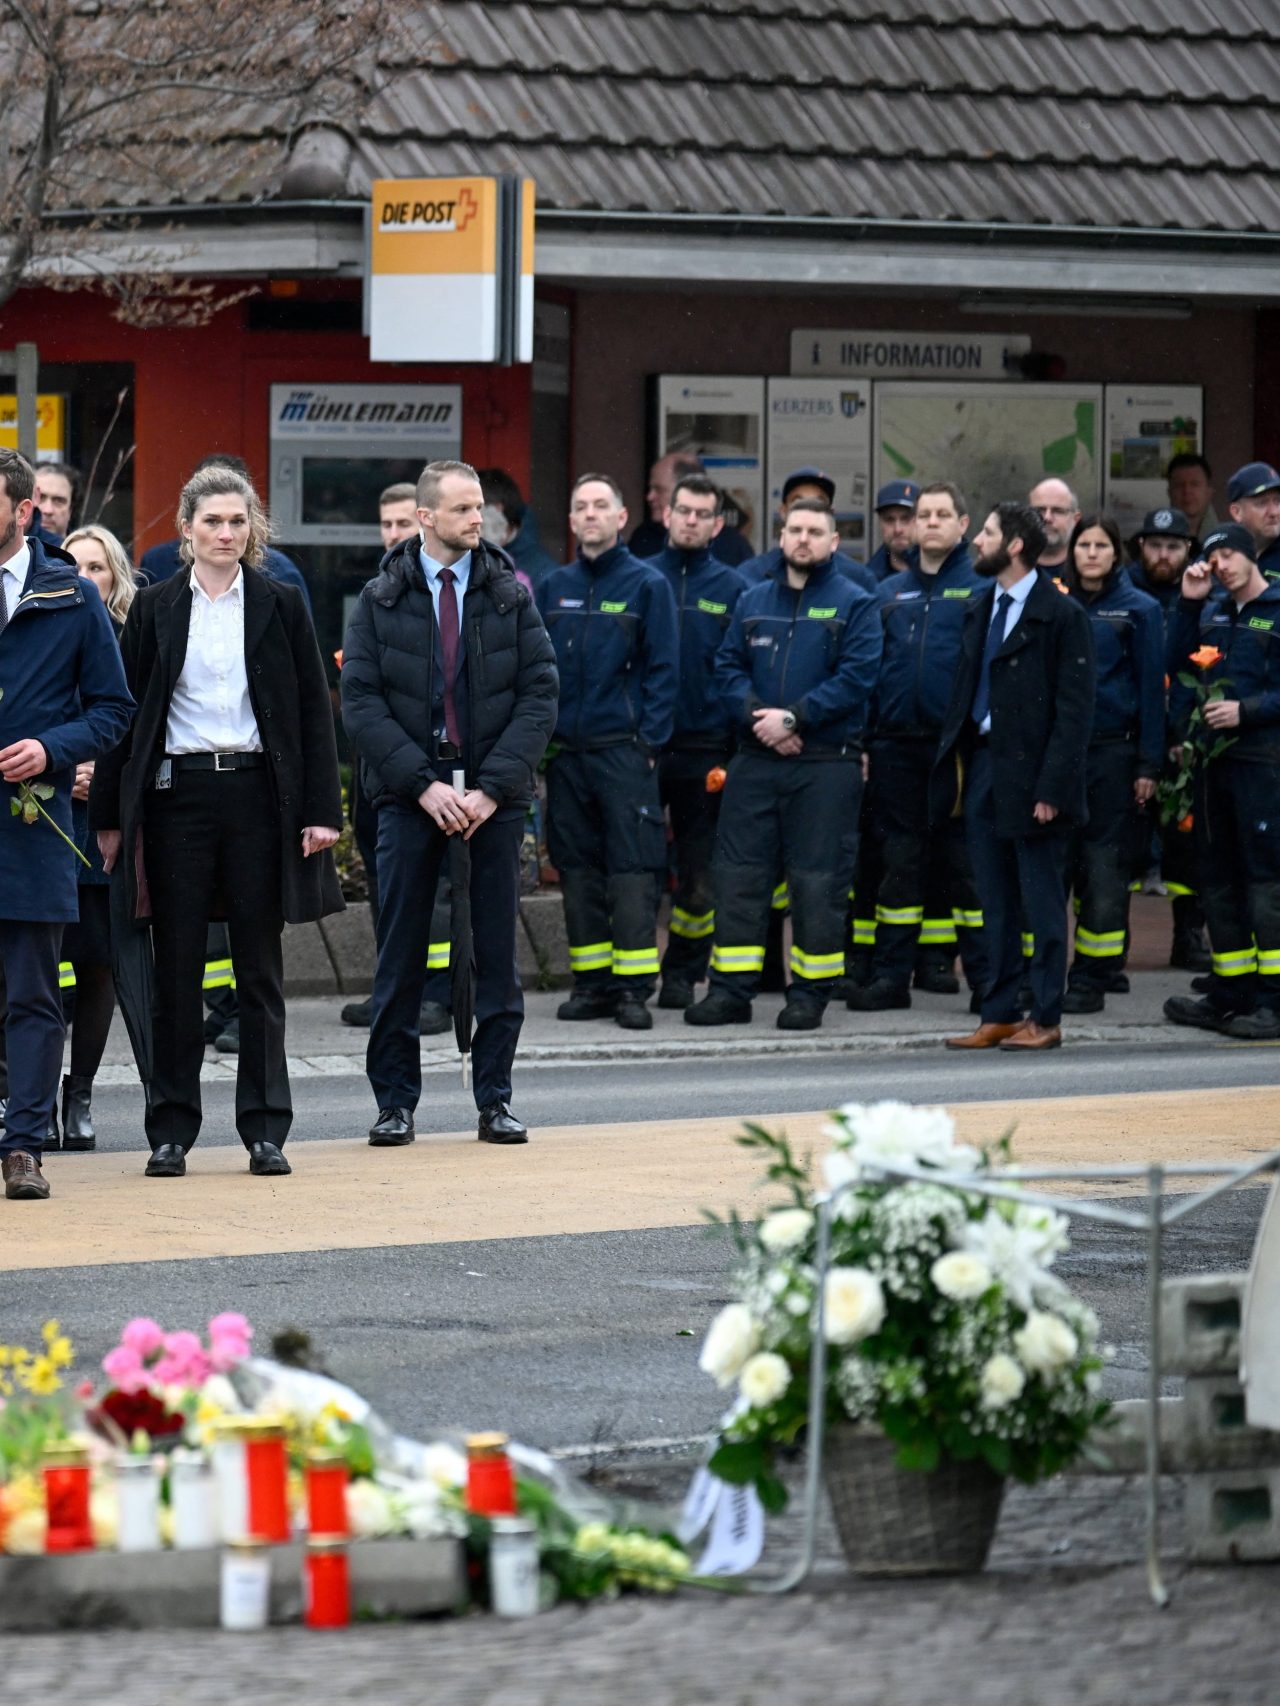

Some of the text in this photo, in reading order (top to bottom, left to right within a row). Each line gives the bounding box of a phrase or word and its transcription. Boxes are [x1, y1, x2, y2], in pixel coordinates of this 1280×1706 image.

[382, 201, 456, 224] DIE POST
[840, 343, 982, 369] INFORMATION
[773, 399, 835, 416] KERZERS
